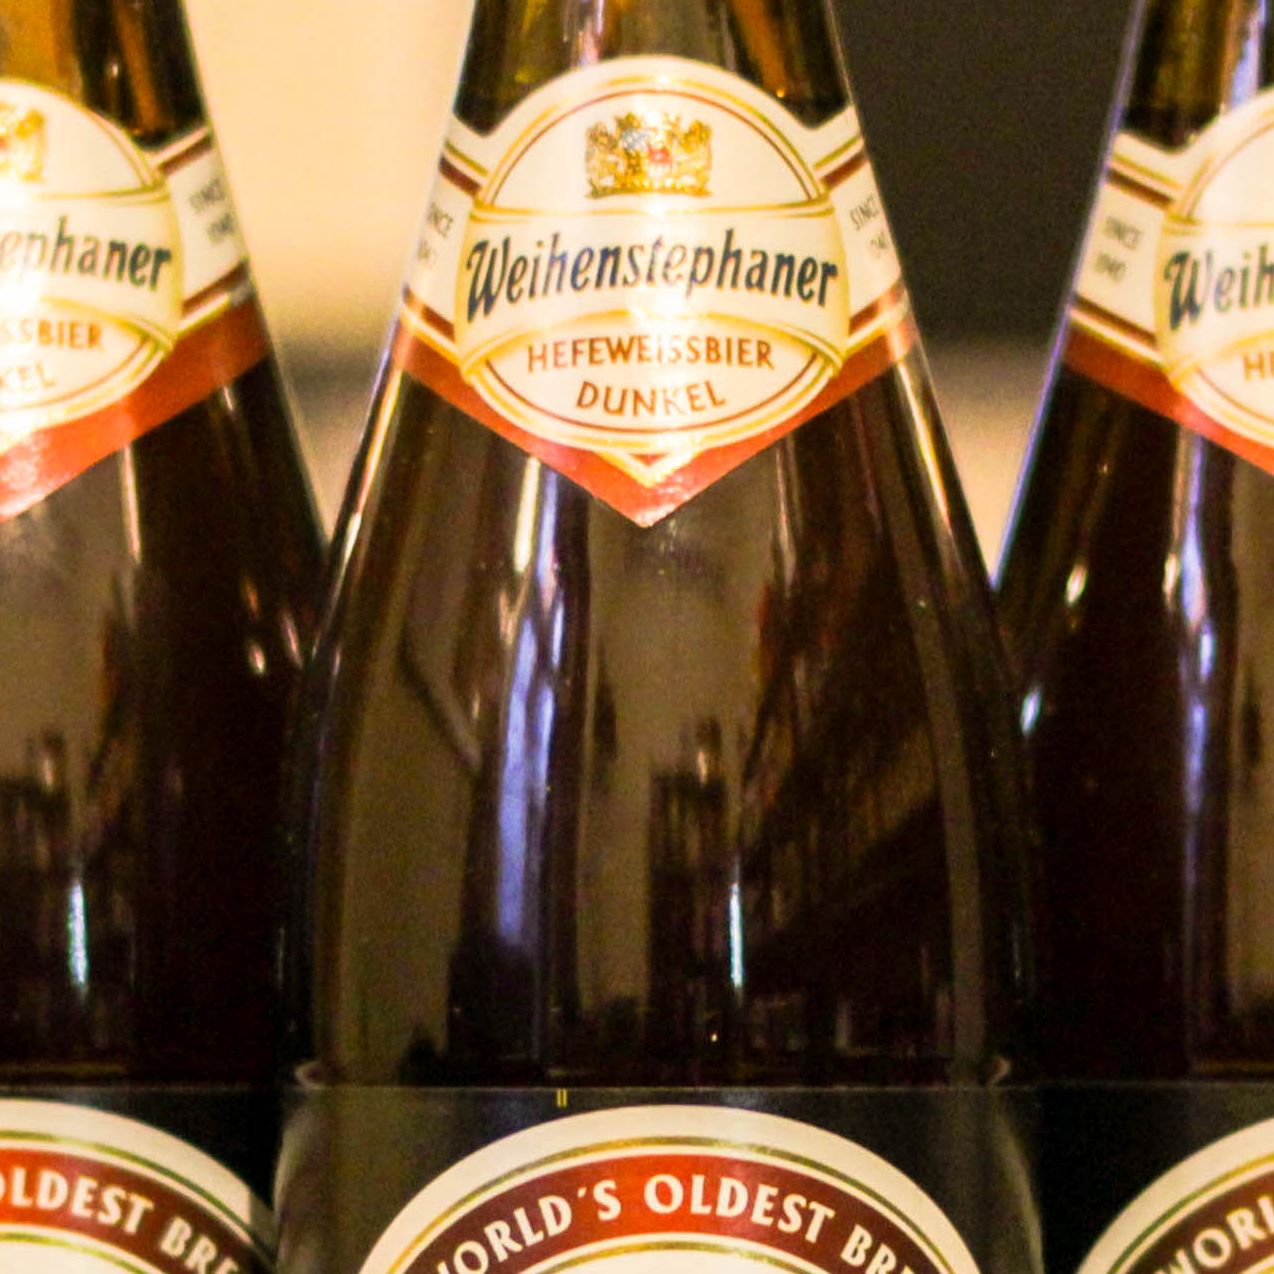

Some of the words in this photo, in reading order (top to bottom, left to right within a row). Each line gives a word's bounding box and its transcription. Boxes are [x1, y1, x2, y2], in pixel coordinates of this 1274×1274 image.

[467, 228, 838, 323] Weihenstephaner
[527, 334, 775, 373] HEFEWEISSBIER
[576, 380, 726, 417] DUNKEL
[644, 1174, 834, 1243] OLDEST
